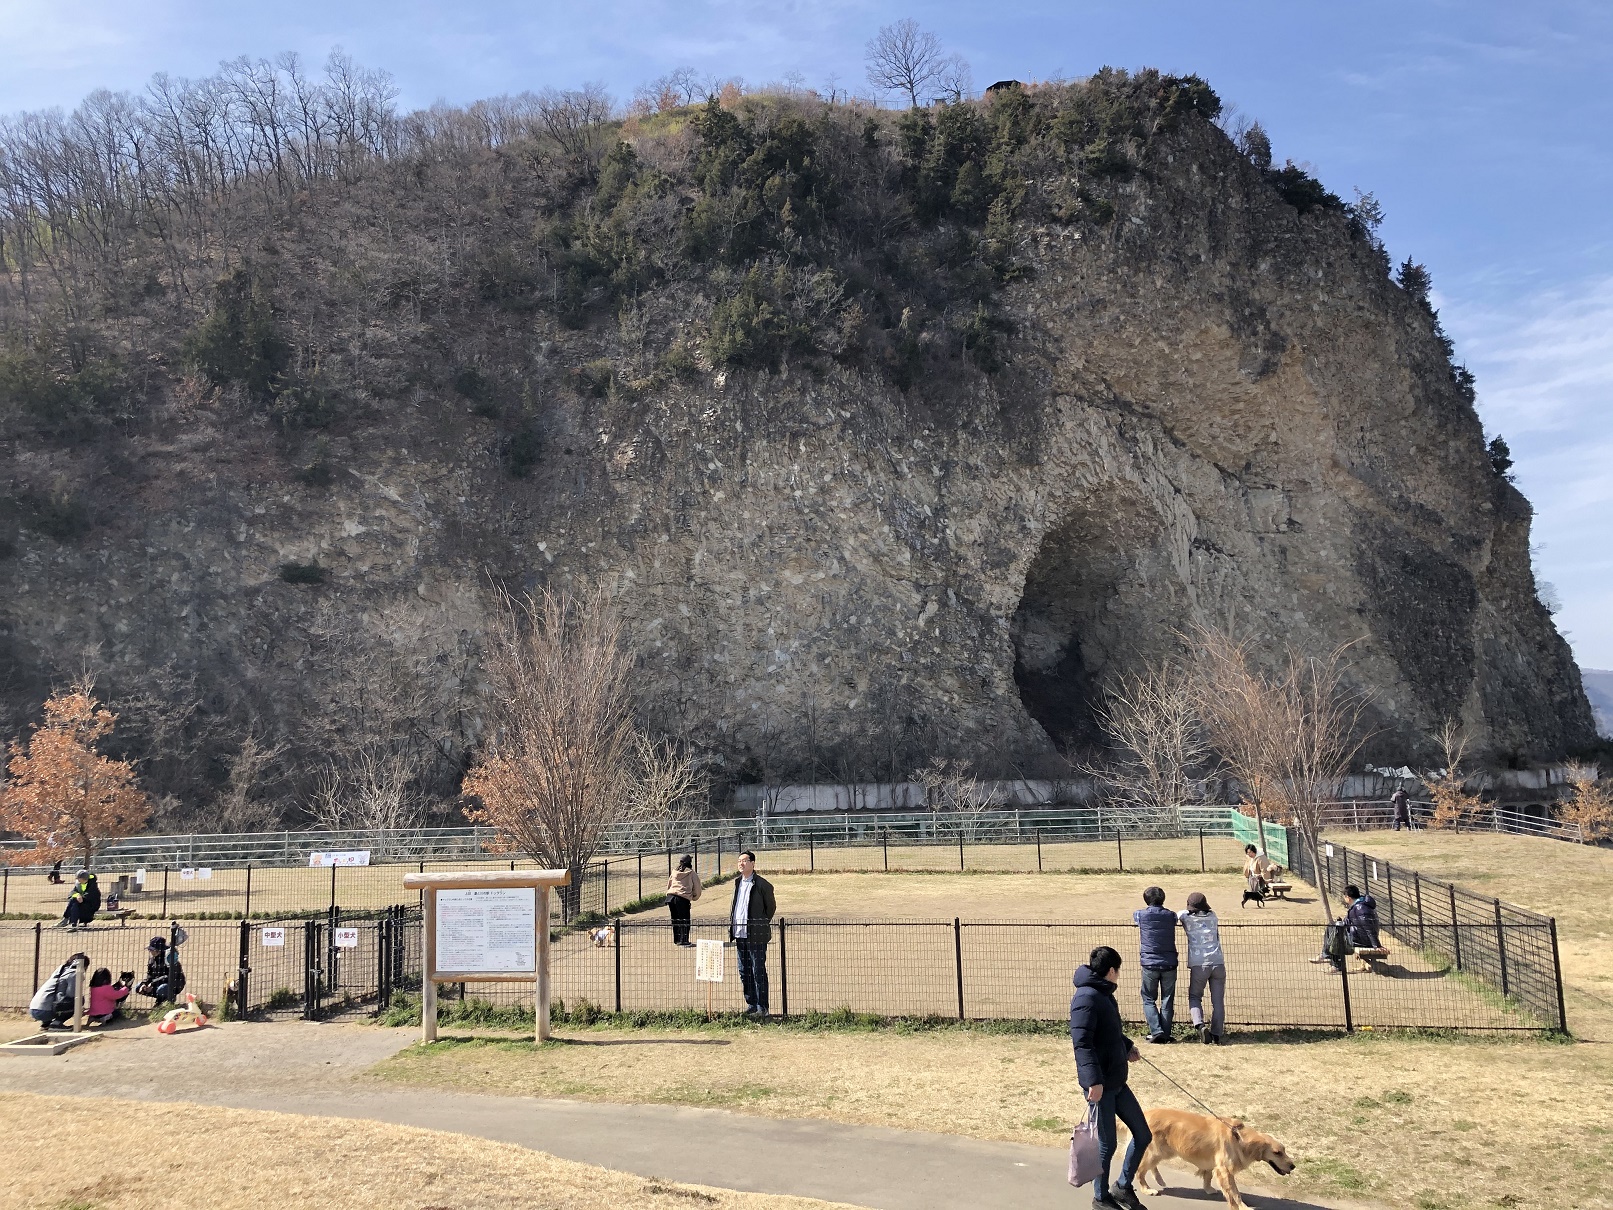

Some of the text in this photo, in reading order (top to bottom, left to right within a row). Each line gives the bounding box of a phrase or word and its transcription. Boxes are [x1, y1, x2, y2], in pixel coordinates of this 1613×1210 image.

[264, 931, 283, 939] 中型犬
[337, 931, 356, 939] 小型犬
